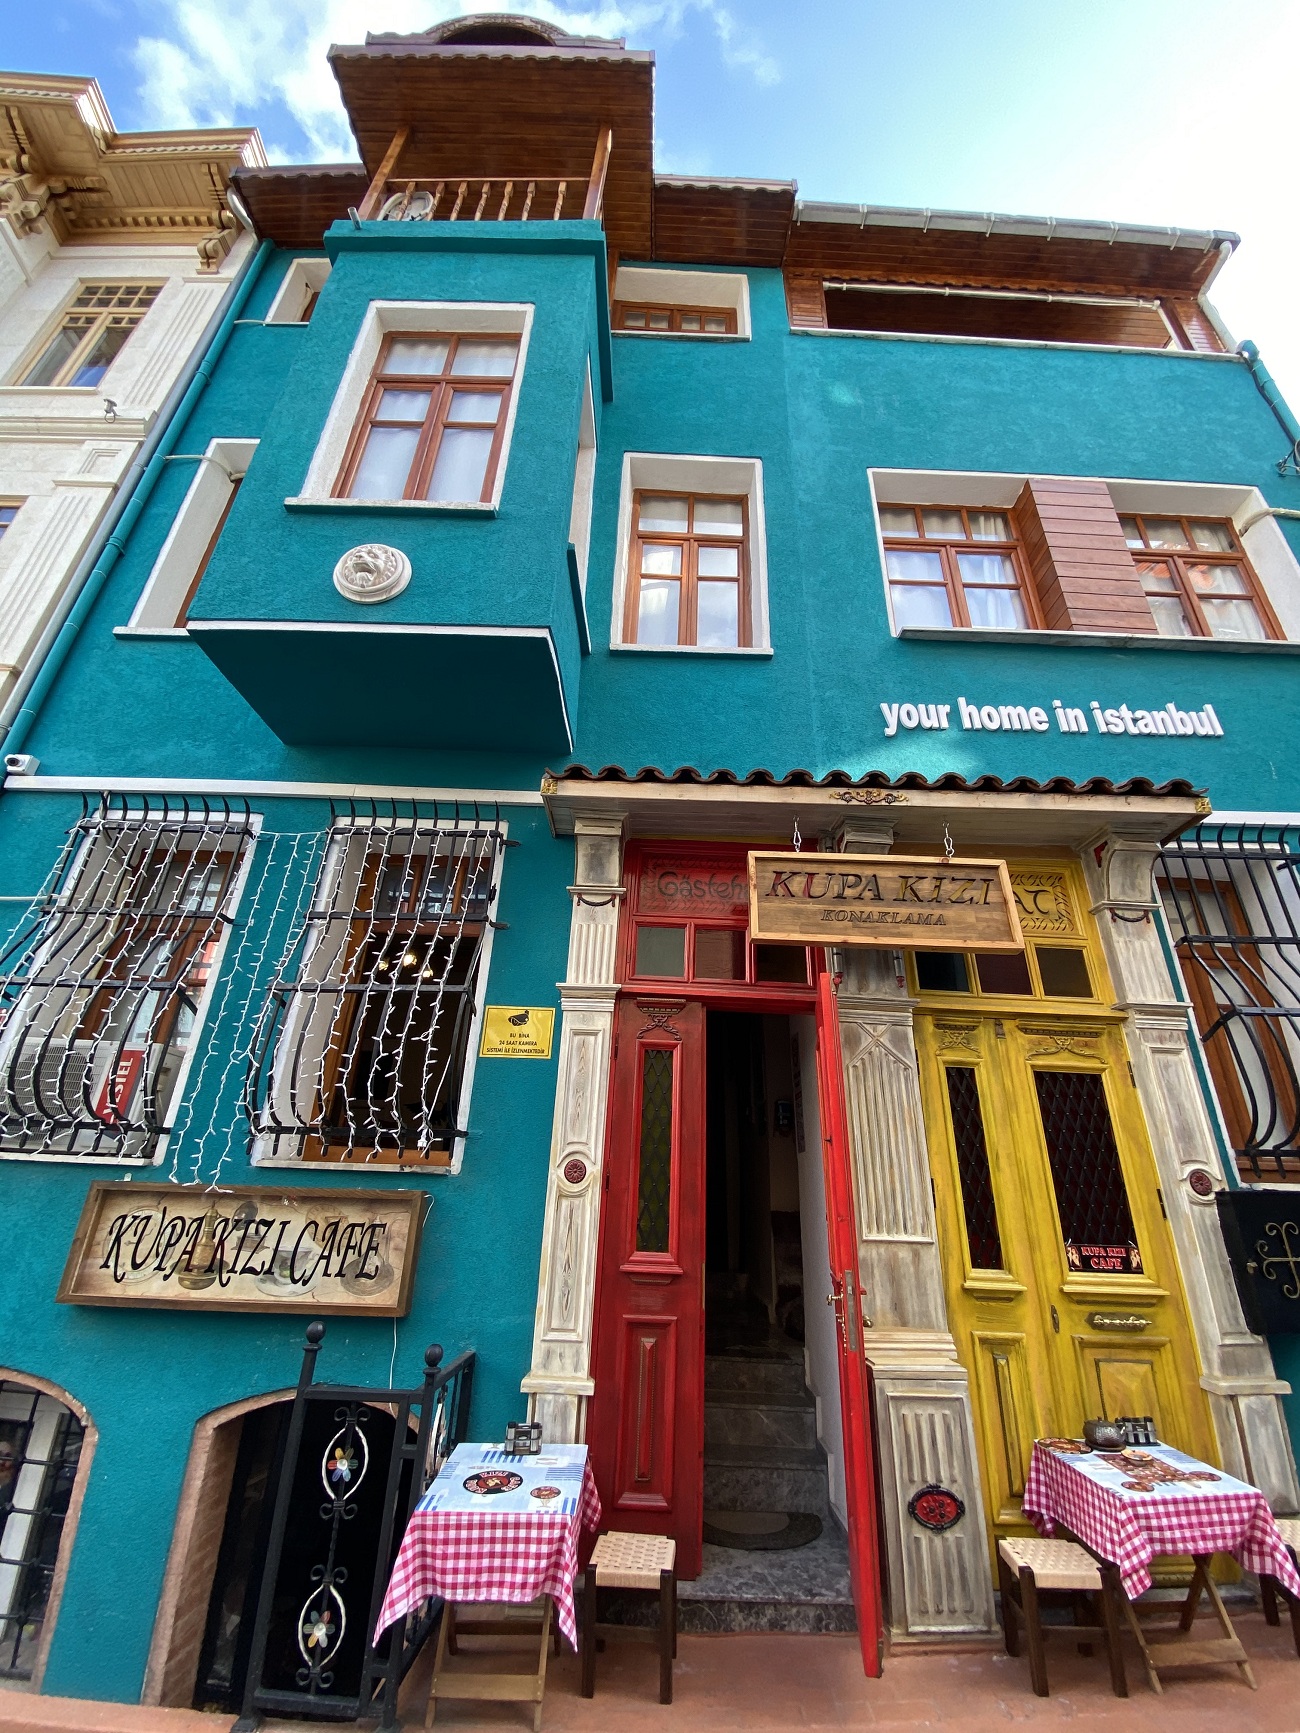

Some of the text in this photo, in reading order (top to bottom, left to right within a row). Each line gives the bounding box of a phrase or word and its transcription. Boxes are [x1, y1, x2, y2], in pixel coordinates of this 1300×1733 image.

[880, 697, 1224, 737] your home in istanbul
[657, 870, 748, 899] Gästeh
[765, 870, 995, 905] KUPA KIZI
[820, 909, 947, 925] KONAKLAMA
[99, 1206, 389, 1288] KUPA KIZI CAFE
[1081, 1246, 1107, 1256] KUPA
[1090, 1257, 1123, 1270] CAFE
